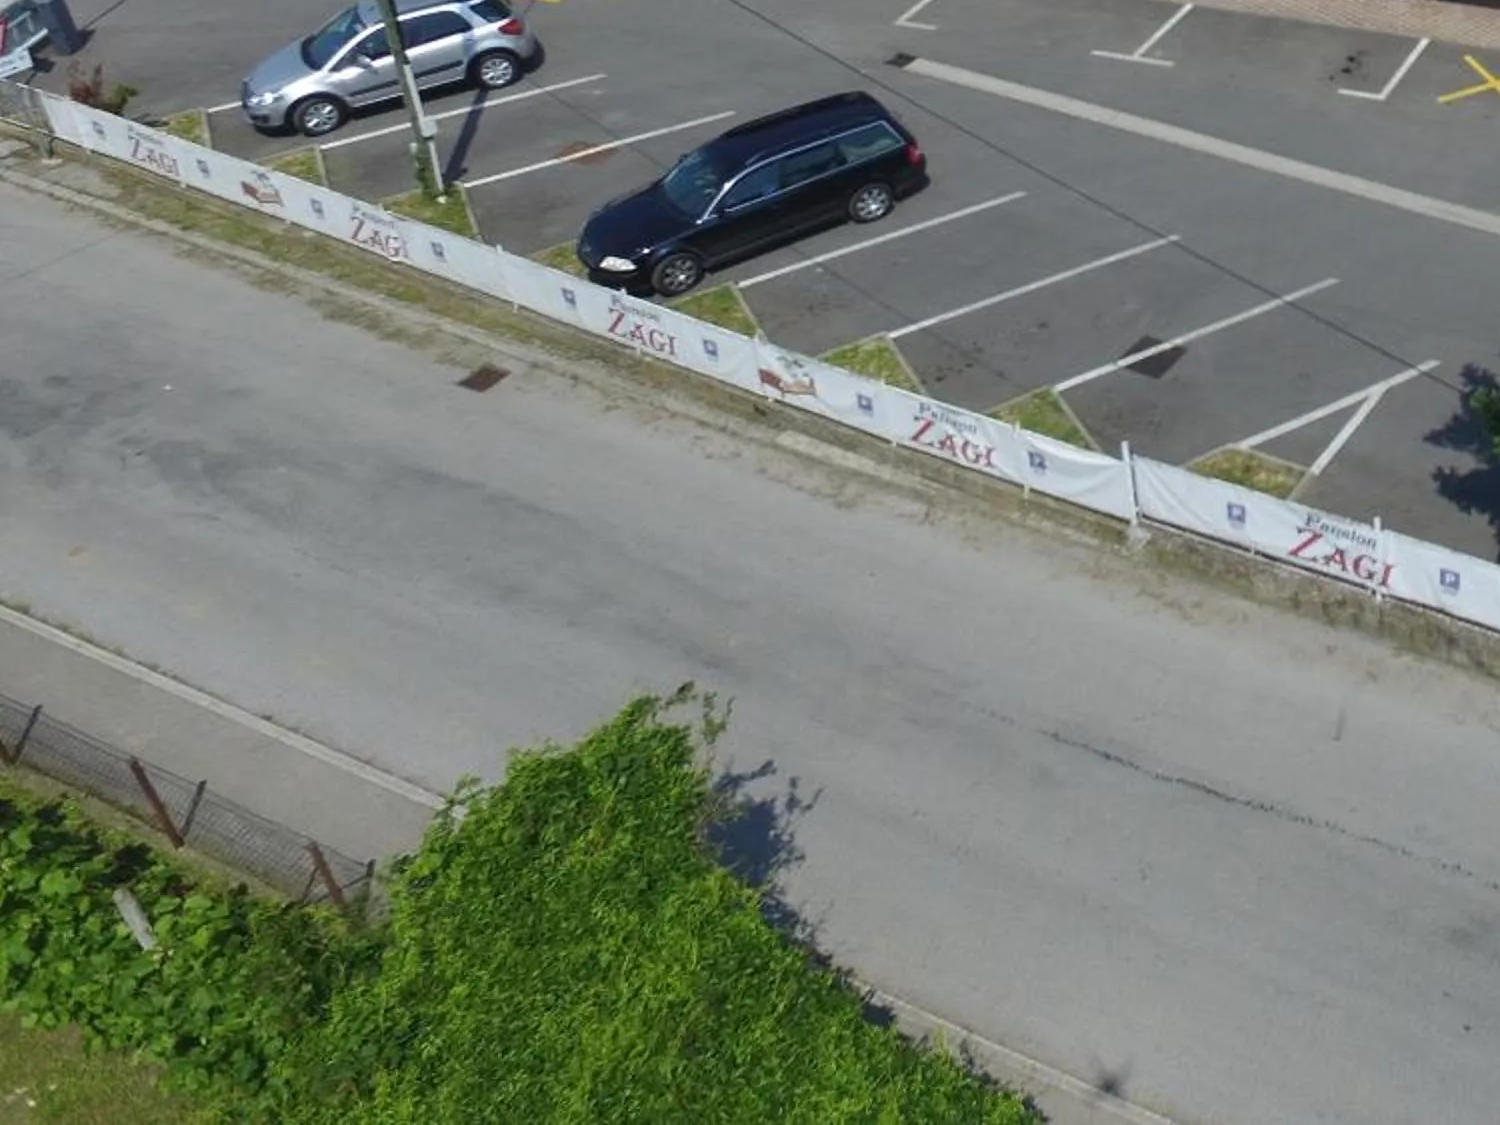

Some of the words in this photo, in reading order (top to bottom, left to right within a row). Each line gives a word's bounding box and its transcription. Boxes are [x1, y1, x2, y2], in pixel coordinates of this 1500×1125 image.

[608, 307, 679, 356] ZAGI
[911, 413, 998, 468] ZAGI
[1287, 525, 1396, 588] ZAGI
